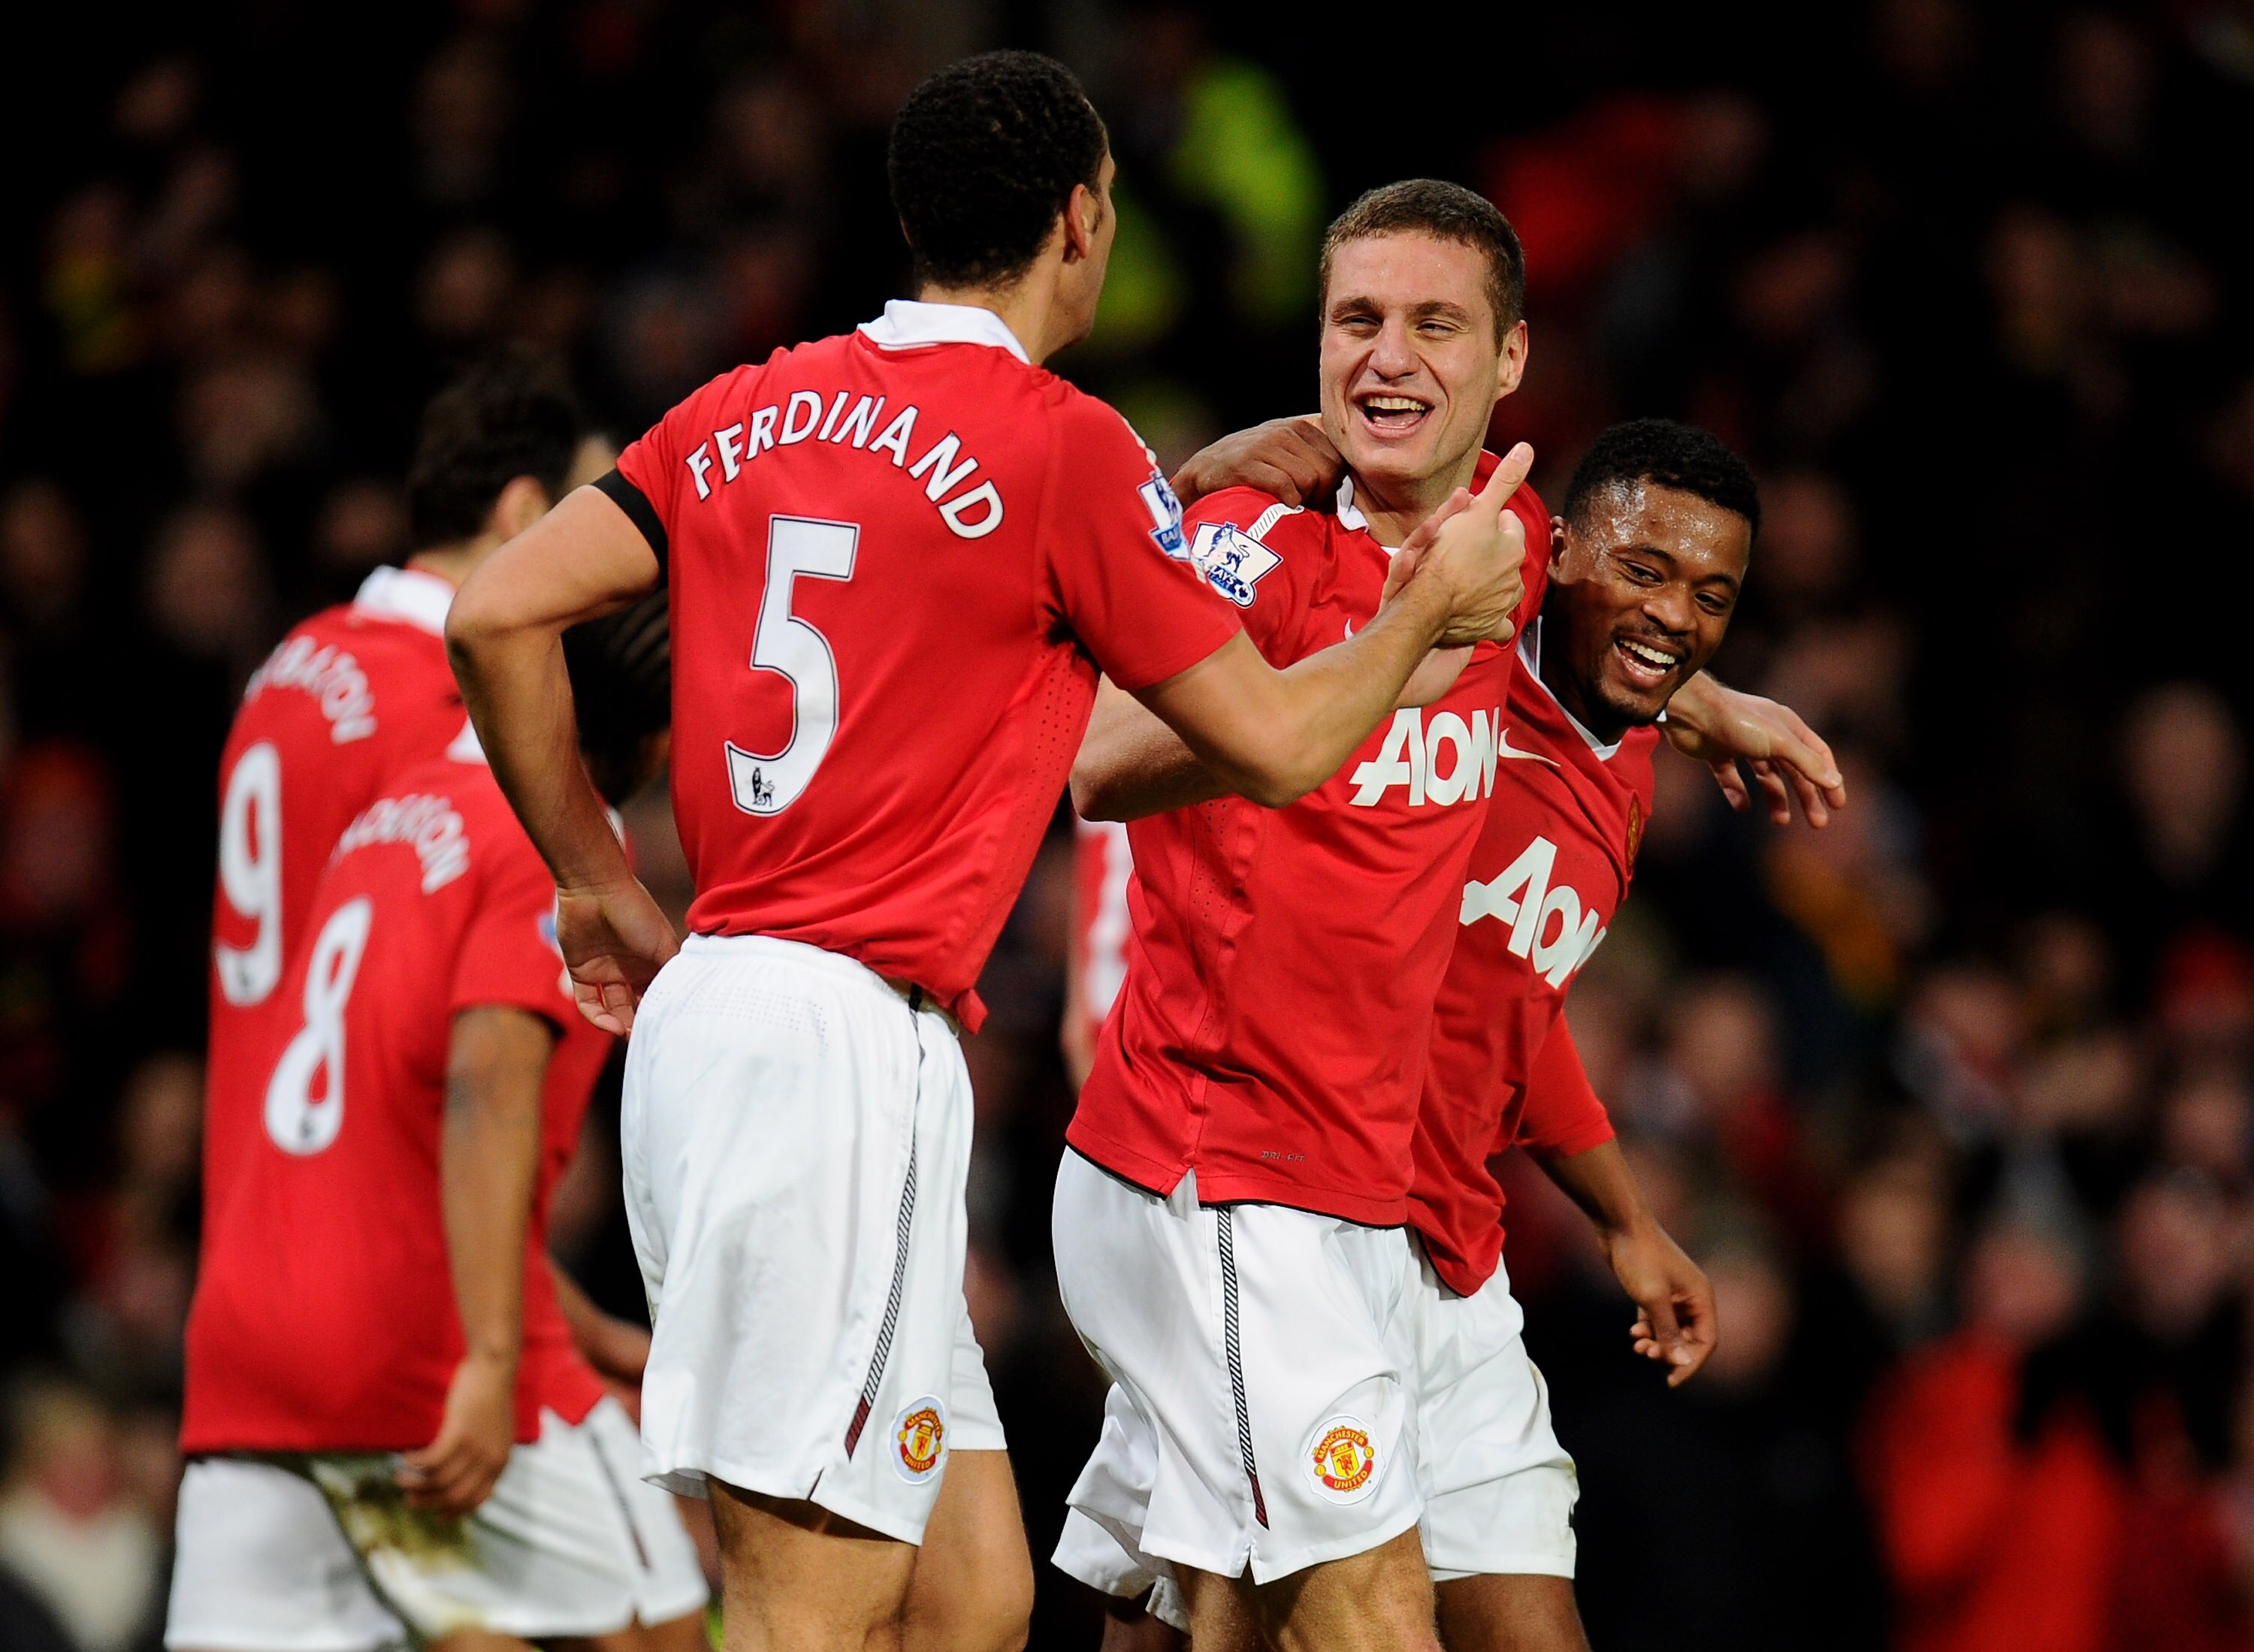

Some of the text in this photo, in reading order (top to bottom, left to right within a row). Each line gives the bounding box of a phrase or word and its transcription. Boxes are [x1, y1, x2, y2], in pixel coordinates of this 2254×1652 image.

[685, 390, 1005, 539] FERDINAND
[724, 514, 861, 817] 5
[1348, 707, 1500, 807] AON
[214, 740, 283, 1007] 9
[1459, 835, 1607, 989] AON
[263, 893, 373, 1157] 8
[905, 1454, 931, 1470] UNITED
[1317, 1429, 1365, 1460] MANCHESTER
[1334, 1469, 1368, 1489] UNITED
